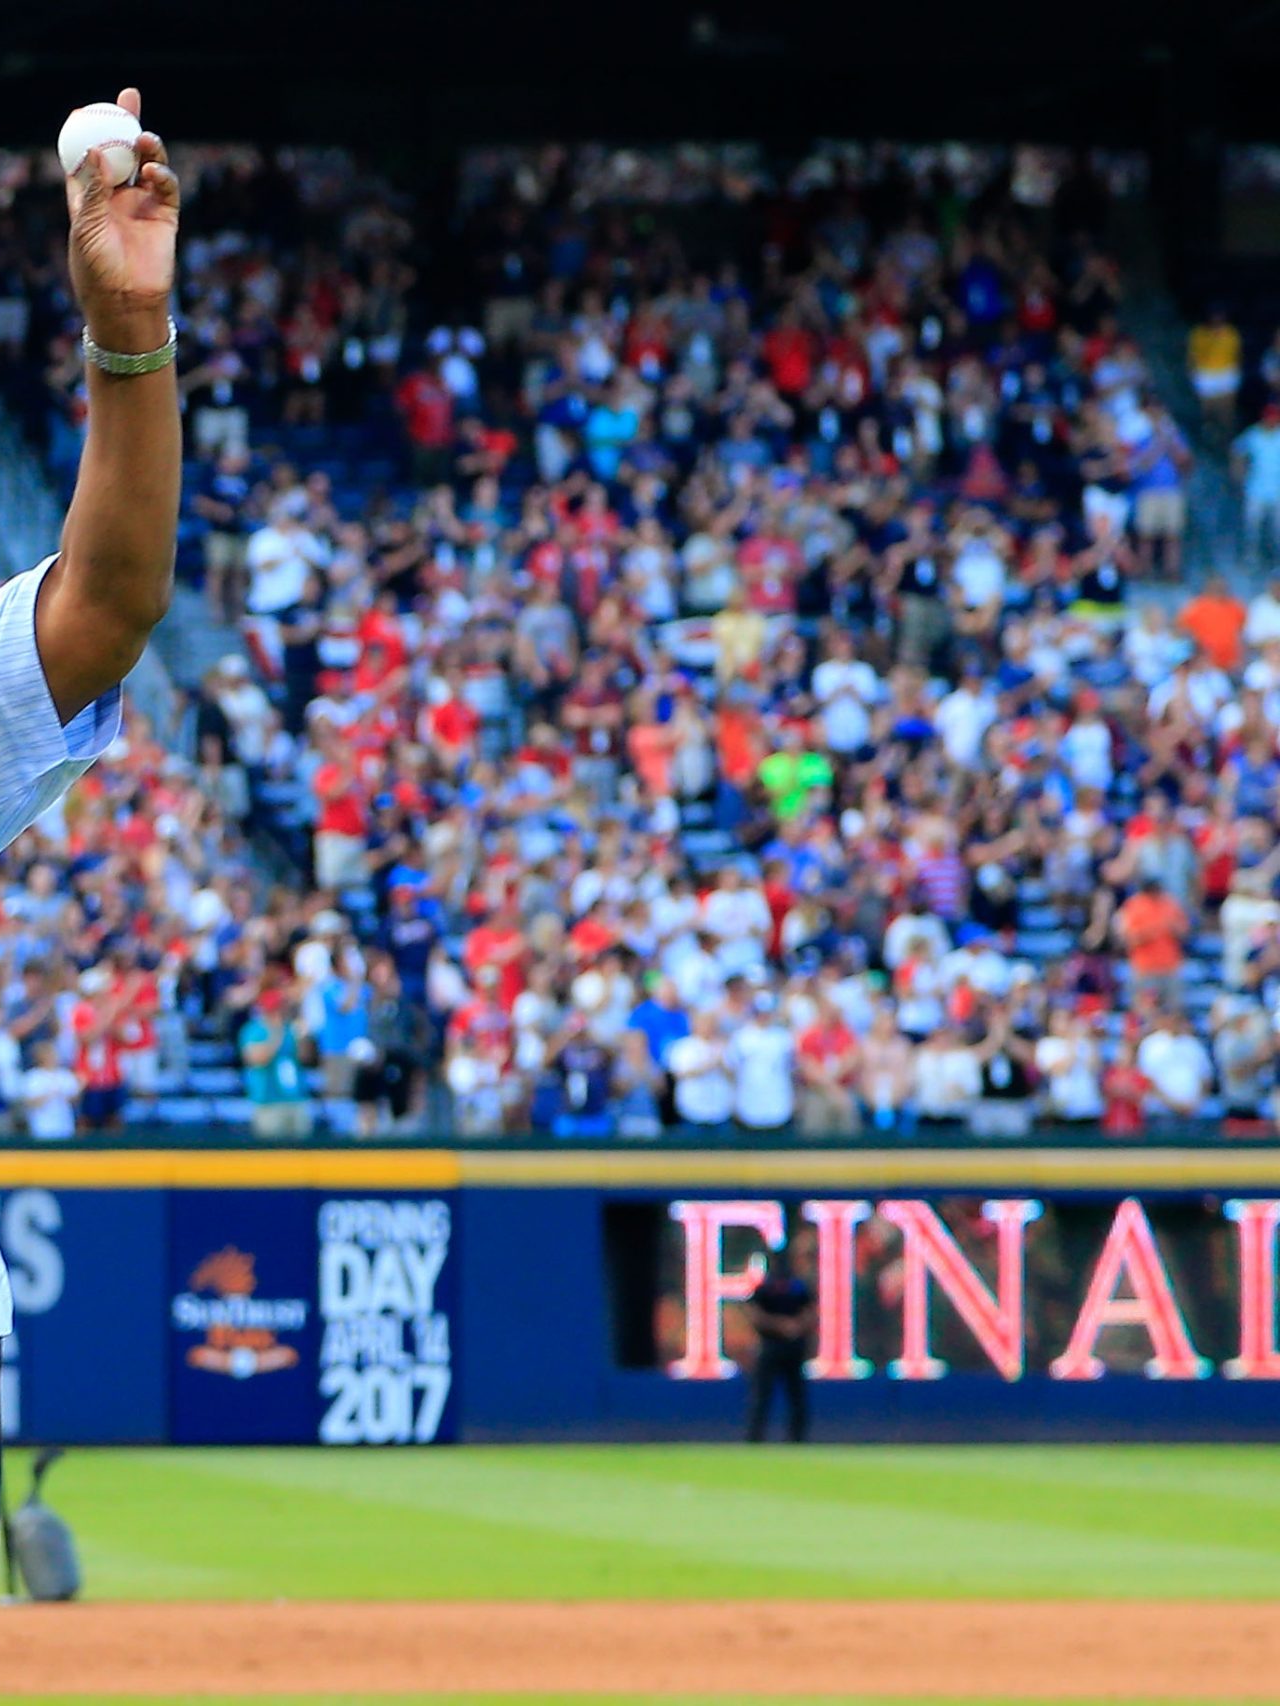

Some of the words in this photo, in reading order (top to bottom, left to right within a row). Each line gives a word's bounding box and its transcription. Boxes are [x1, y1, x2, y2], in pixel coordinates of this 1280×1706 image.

[318, 1200, 450, 1246] OPENING
[320, 1243, 447, 1320] DAY
[319, 1364, 450, 1445] 2017
